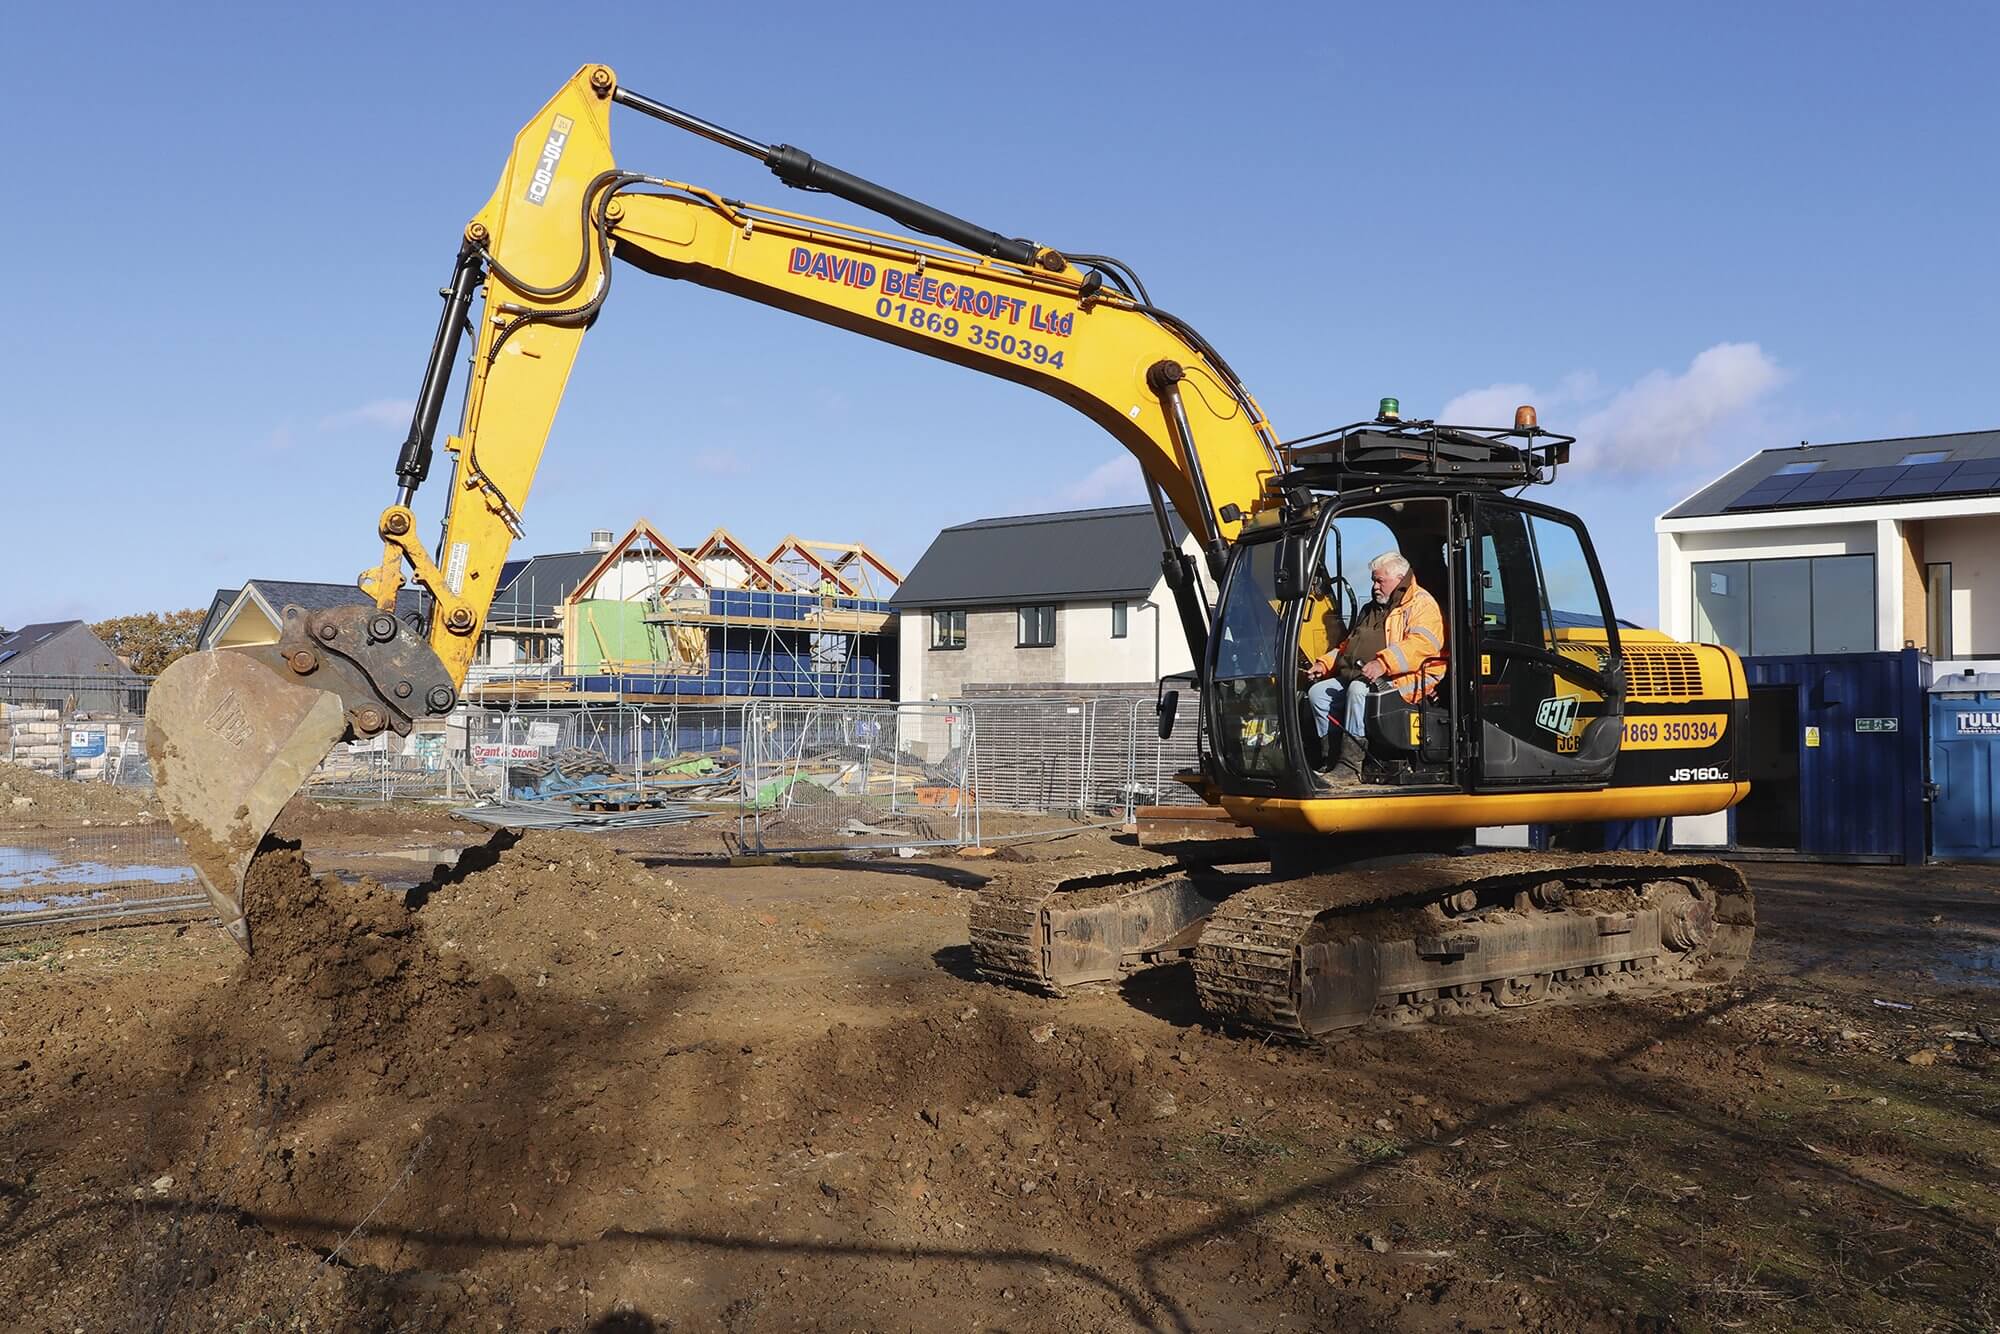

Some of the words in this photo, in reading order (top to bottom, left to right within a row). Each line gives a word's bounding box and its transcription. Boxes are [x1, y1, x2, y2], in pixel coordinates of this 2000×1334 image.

[788, 247, 876, 289] DAVID
[880, 268, 1027, 325] BEECROFT
[1029, 303, 1075, 338] Ltd
[875, 297, 960, 338] 01869
[967, 324, 1065, 370] 350394
[474, 745, 500, 758] Grant
[511, 747, 538, 759] Stone
[1663, 721, 1718, 742] 350394
